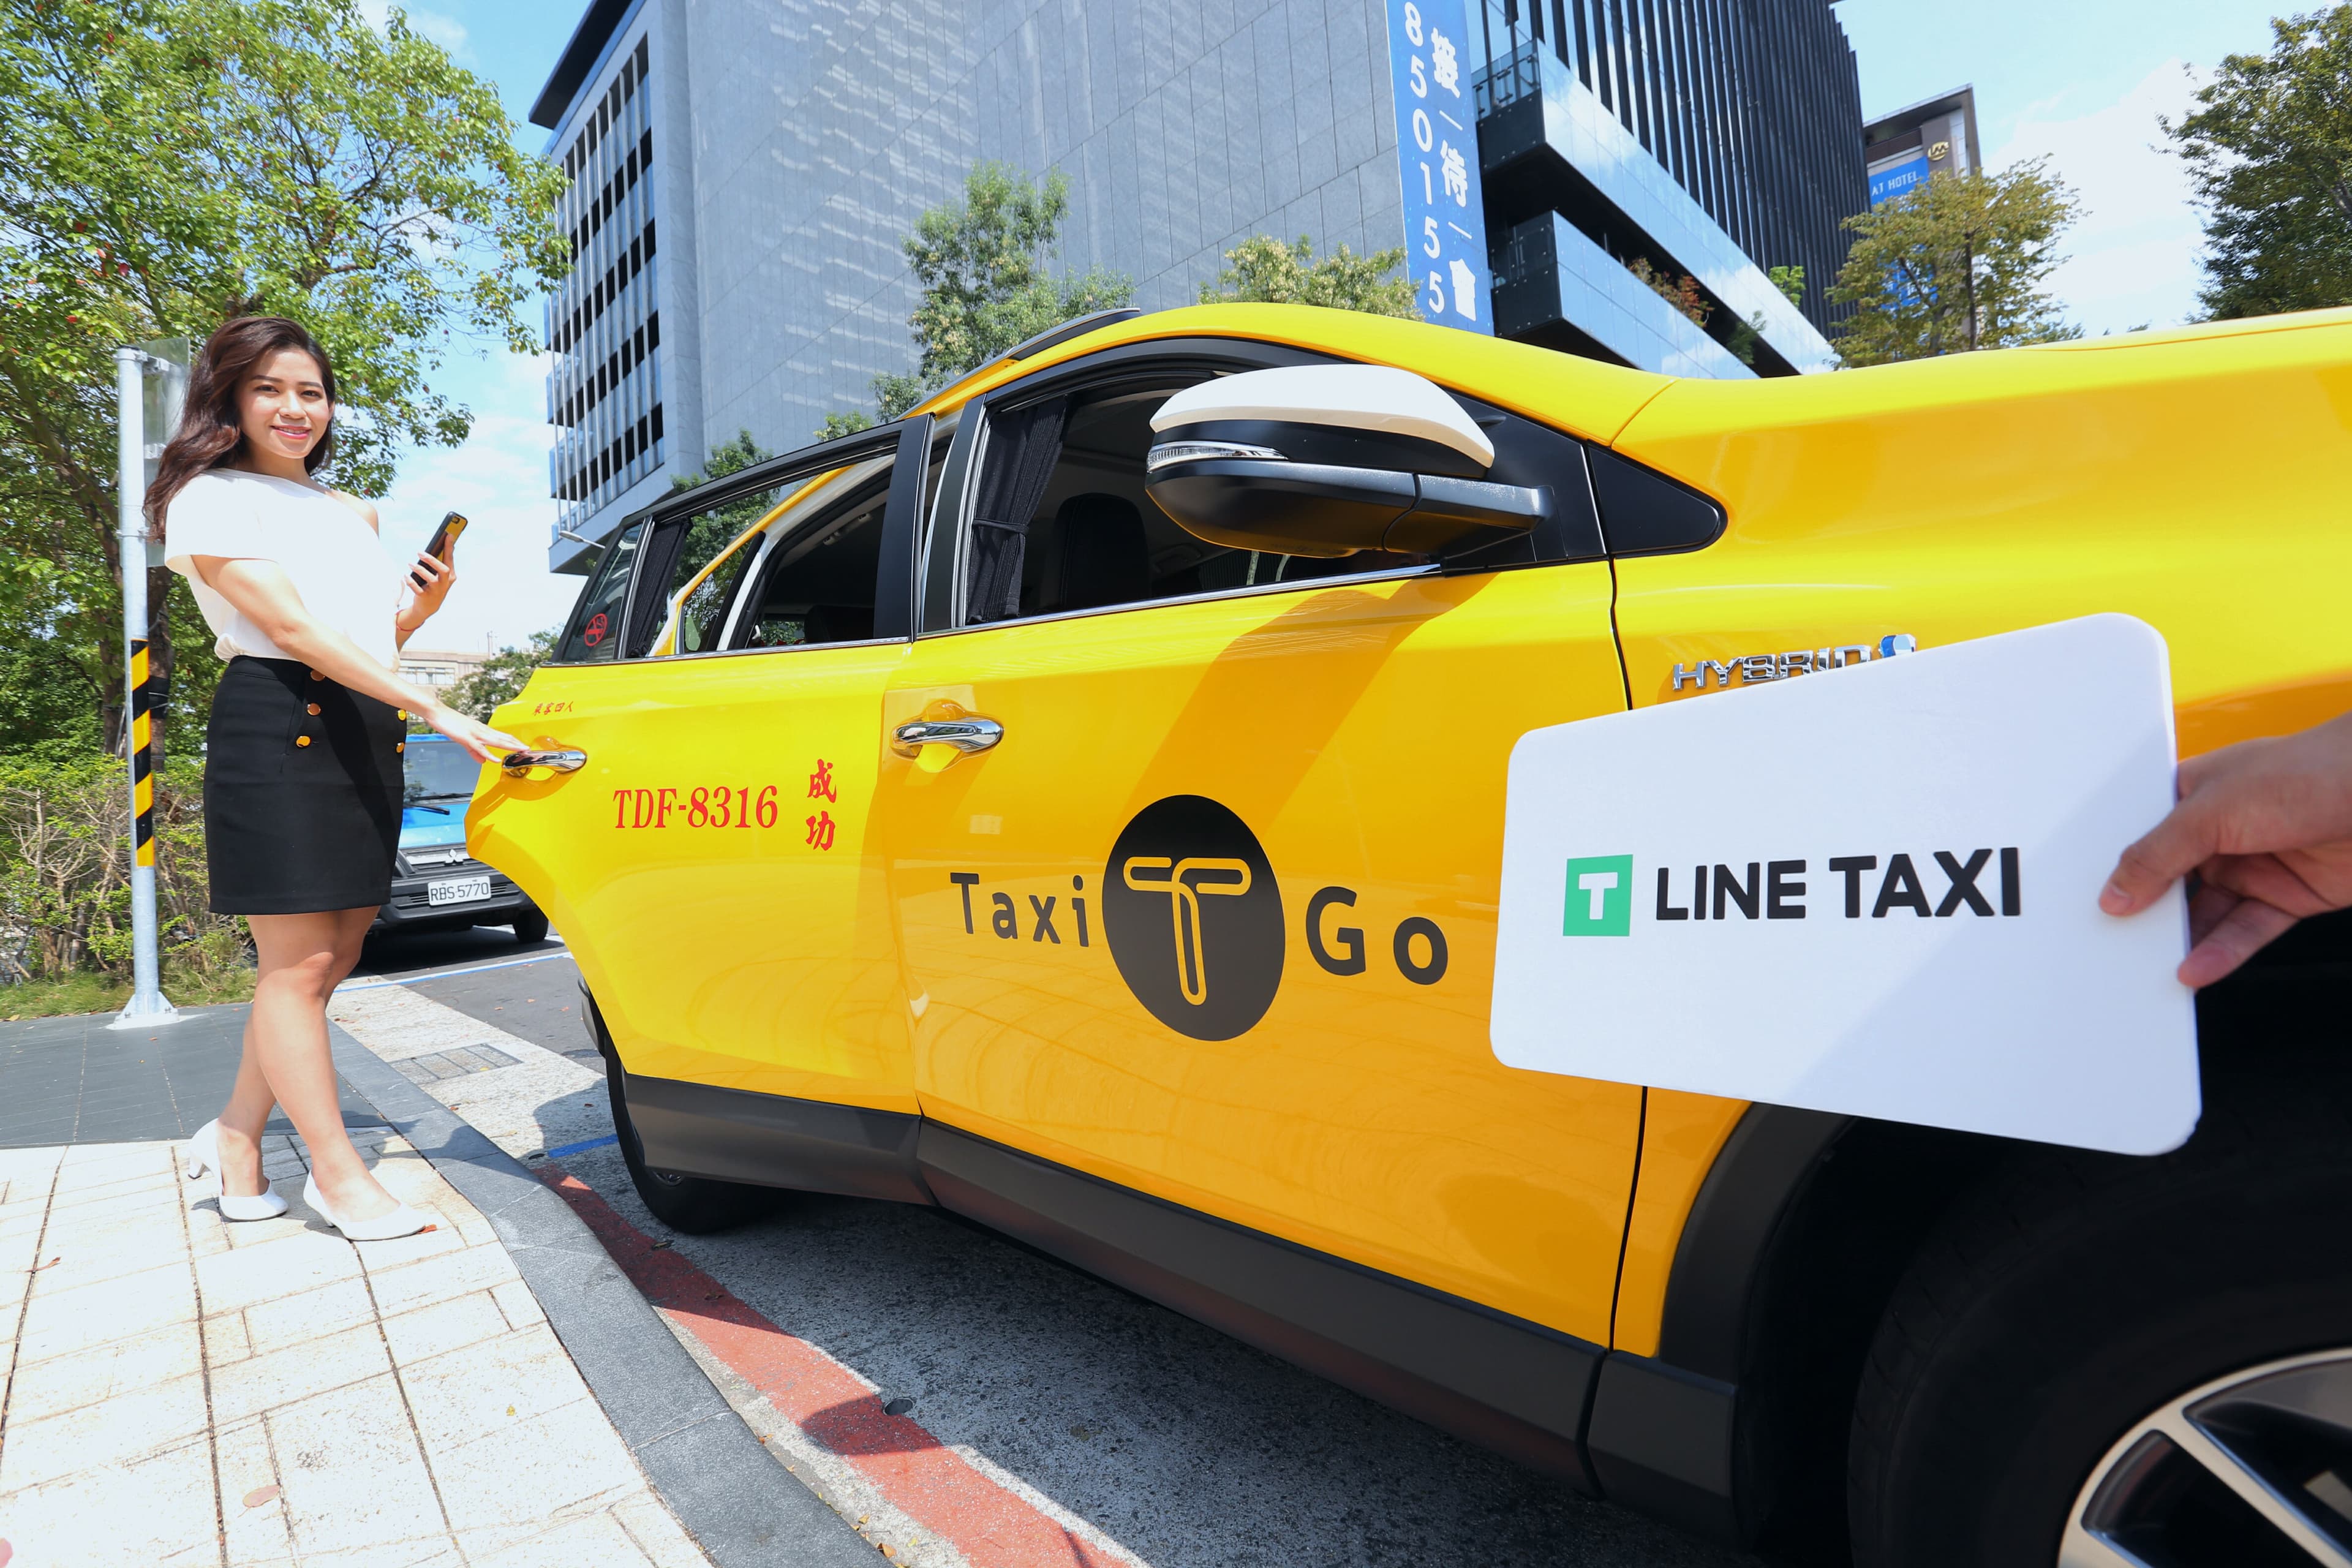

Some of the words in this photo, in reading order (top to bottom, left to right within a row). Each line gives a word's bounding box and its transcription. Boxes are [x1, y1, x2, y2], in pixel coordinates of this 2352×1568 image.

[1888, 171, 1918, 190] HOTEL
[613, 785, 778, 829] TDF-8316
[805, 758, 837, 851] 成功
[1656, 859, 1806, 920] LINE
[1829, 847, 2021, 918] TAXI
[950, 872, 1090, 947] Taxi
[1305, 886, 1449, 986] Go
